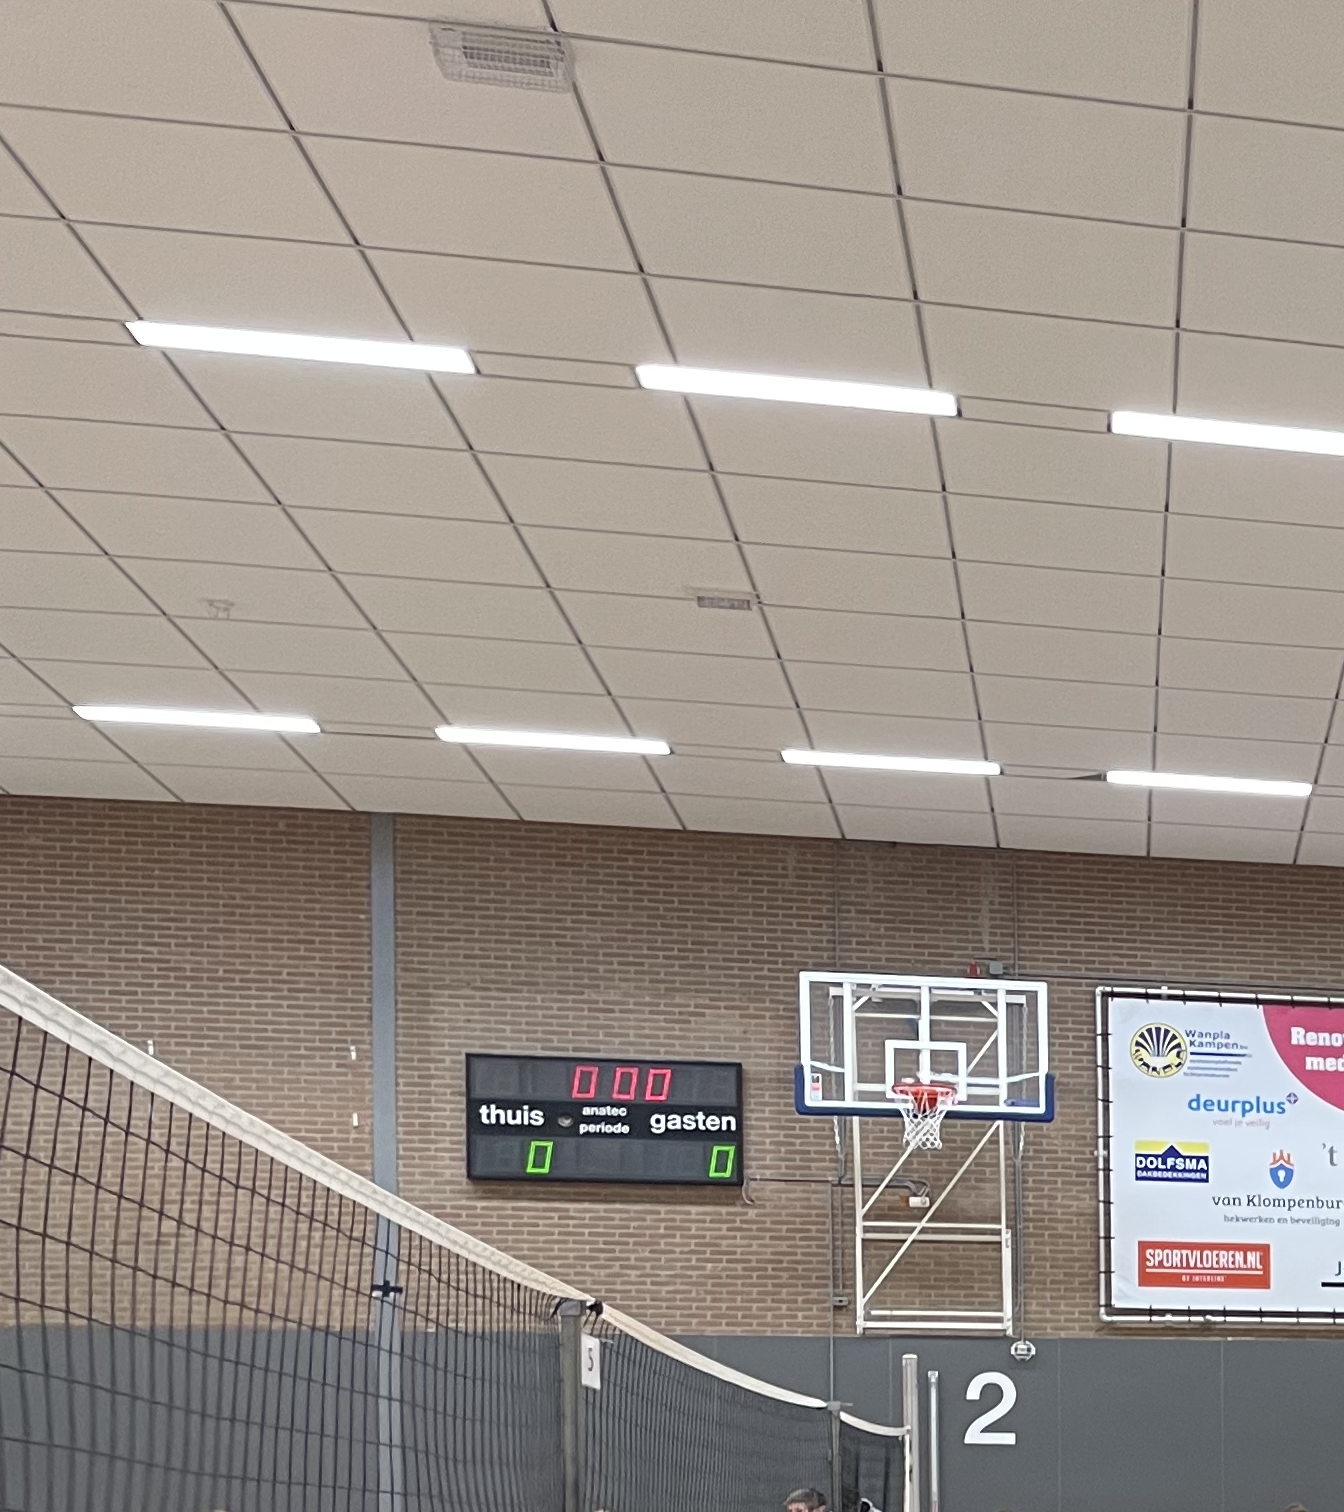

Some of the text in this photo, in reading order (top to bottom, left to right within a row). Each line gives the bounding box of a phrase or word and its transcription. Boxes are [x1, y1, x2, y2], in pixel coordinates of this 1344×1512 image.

[1185, 1029, 1231, 1040] Wanpla
[1189, 1039, 1239, 1050] Kampen
[479, 1104, 545, 1126] thuis
[1188, 1093, 1286, 1117] deurplus
[579, 1121, 630, 1135] periode
[649, 1112, 736, 1134] gasten
[526, 1140, 553, 1174] 0
[709, 1145, 736, 1177] 0
[1136, 1156, 1208, 1171] DOLFSMA
[1212, 1196, 1242, 1207] van
[1223, 1214, 1275, 1224] hekwerken
[1277, 1216, 1288, 1224] en
[1145, 1248, 1263, 1270] SPORTVLOEREN.NL
[964, 1371, 1017, 1445] 2
